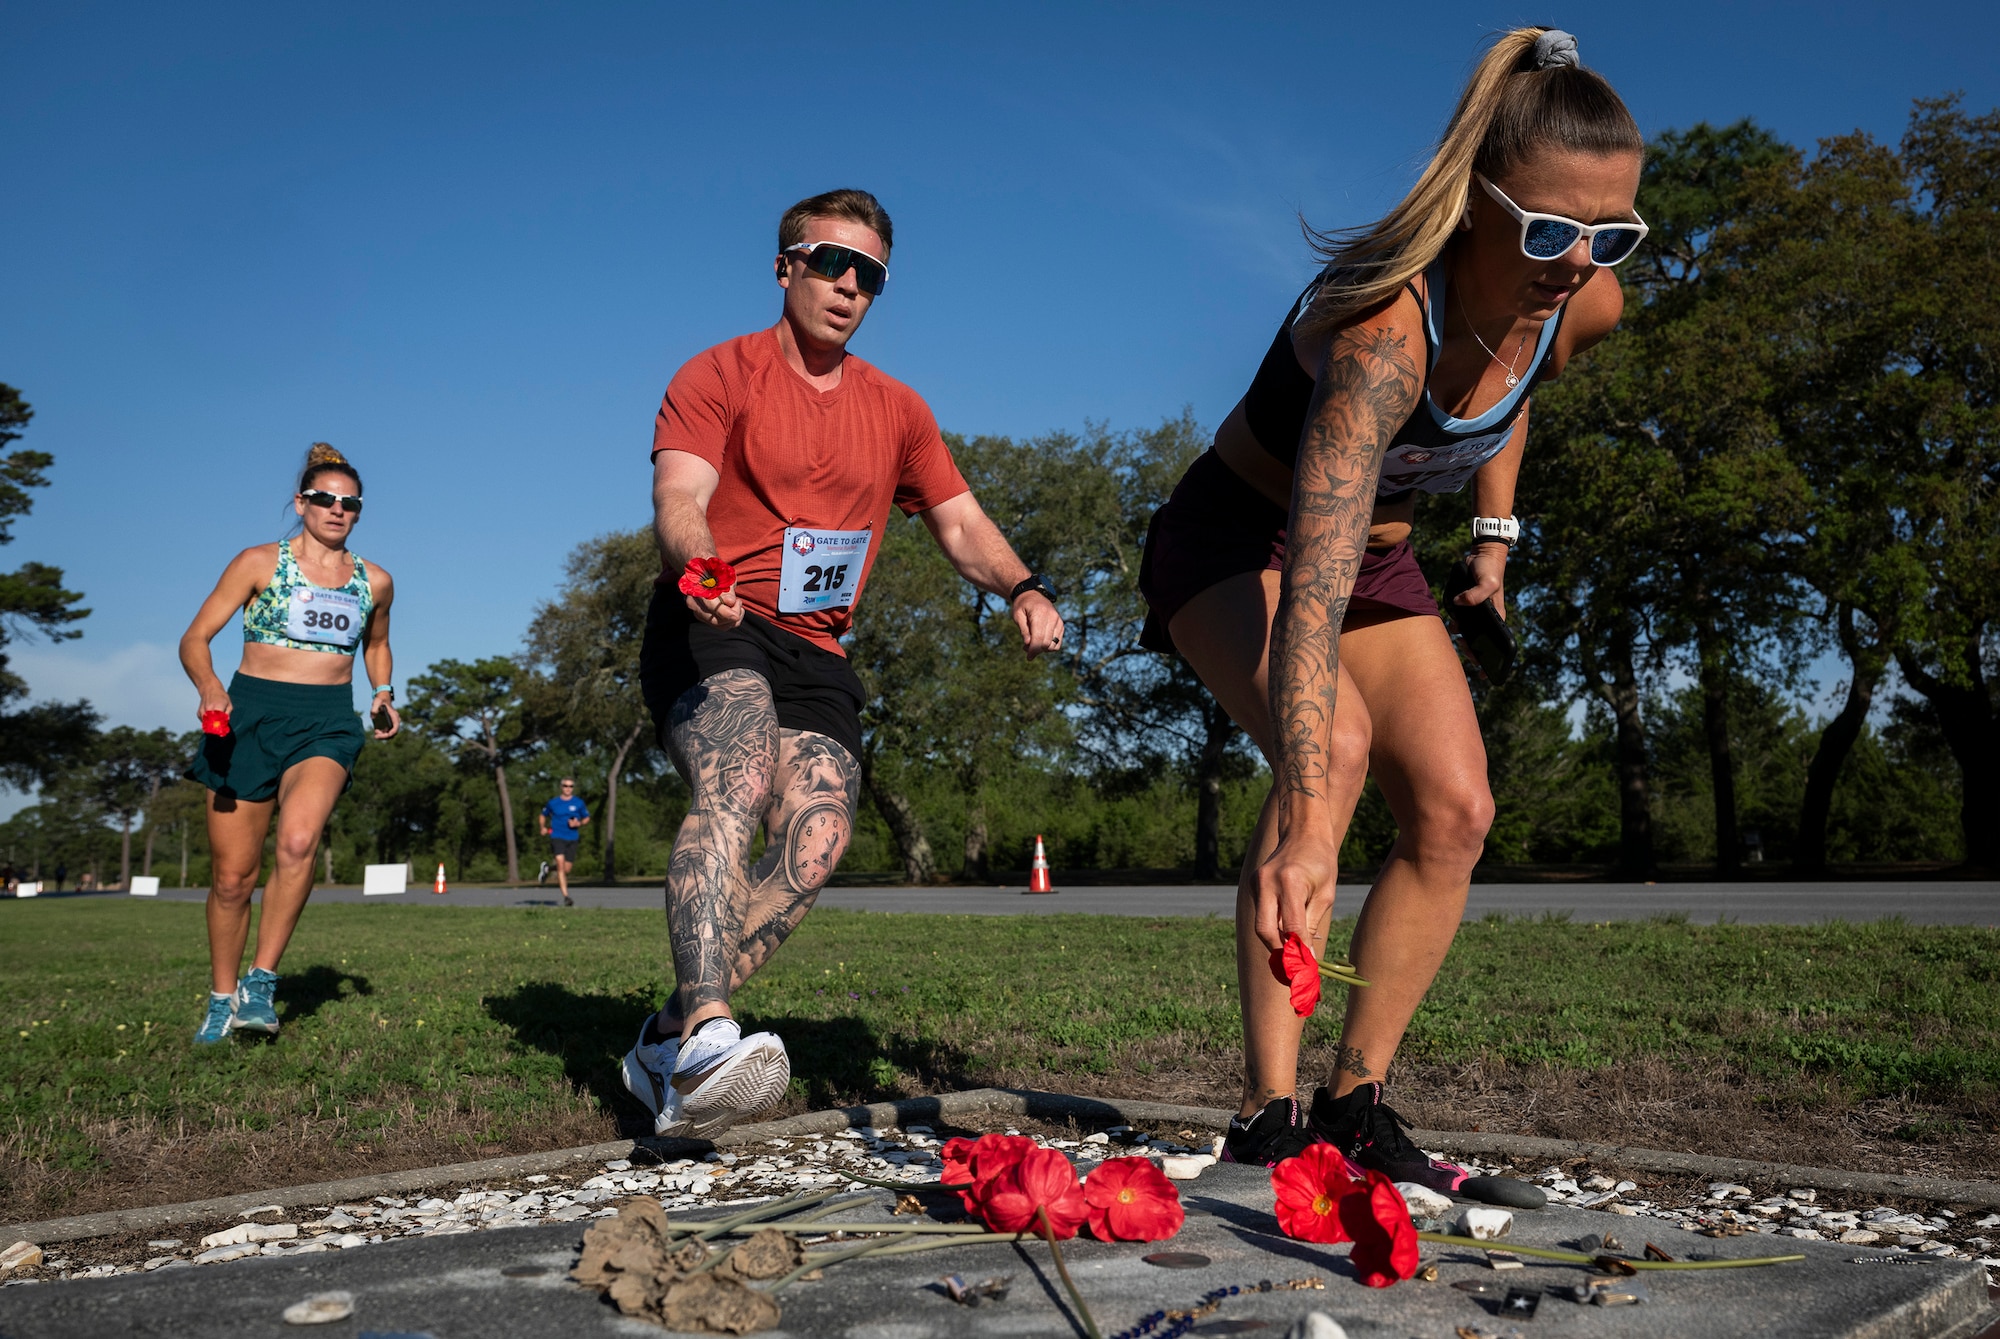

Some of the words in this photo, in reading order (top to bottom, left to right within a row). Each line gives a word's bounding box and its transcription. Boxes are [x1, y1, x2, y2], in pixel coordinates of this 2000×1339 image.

[1469, 442, 1484, 451] TO
[816, 537, 839, 545] GATE
[851, 537, 867, 545] GATE
[803, 564, 848, 592] 215
[303, 610, 350, 631] 380
[820, 816, 826, 827] 9
[806, 826, 812, 836] 8
[802, 860, 808, 868] 6
[1290, 1098, 1298, 1127] aucon
